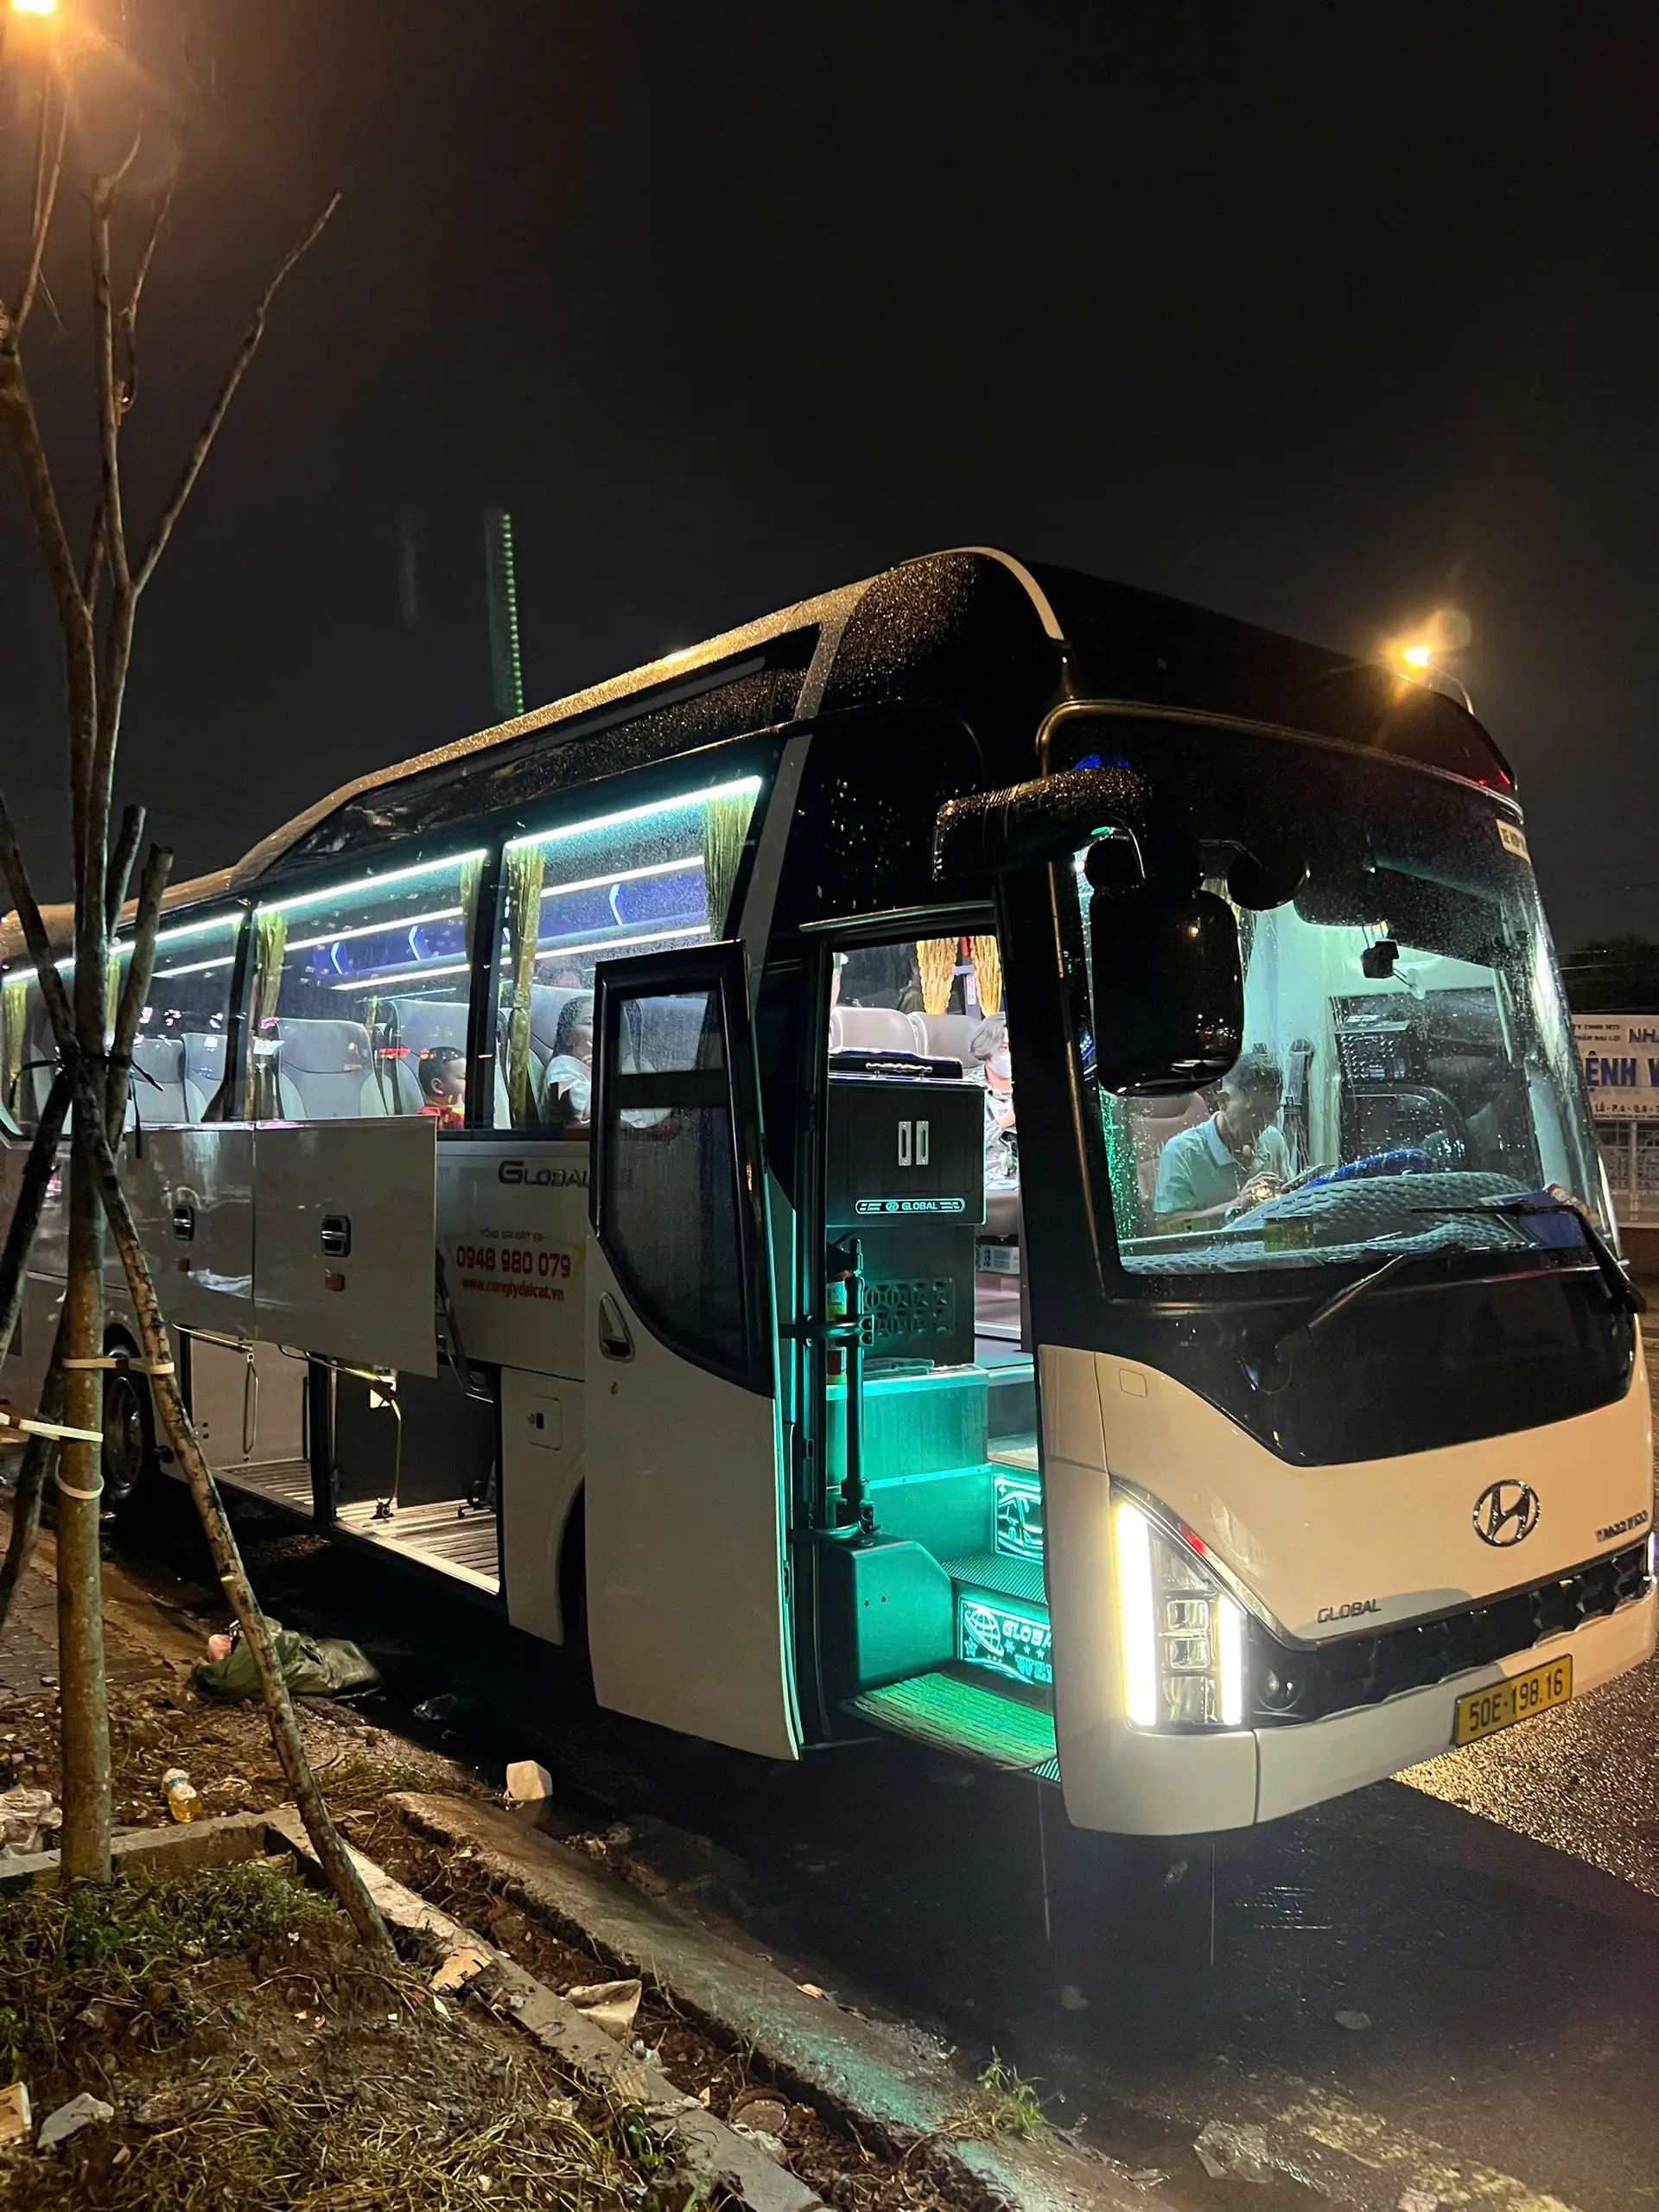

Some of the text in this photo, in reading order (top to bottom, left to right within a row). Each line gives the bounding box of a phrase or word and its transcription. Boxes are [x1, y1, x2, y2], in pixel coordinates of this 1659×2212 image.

[1629, 1028, 1659, 1044] NH
[1585, 1050, 1637, 1093] ỆNH
[498, 1160, 589, 1188] GLOBAL
[901, 1202, 938, 1211] GLOBAL
[456, 1245, 571, 1279] 0948 980 079
[1317, 1599, 1382, 1624] GLOBAL
[1469, 1669, 1563, 1732] 50E-198.16
